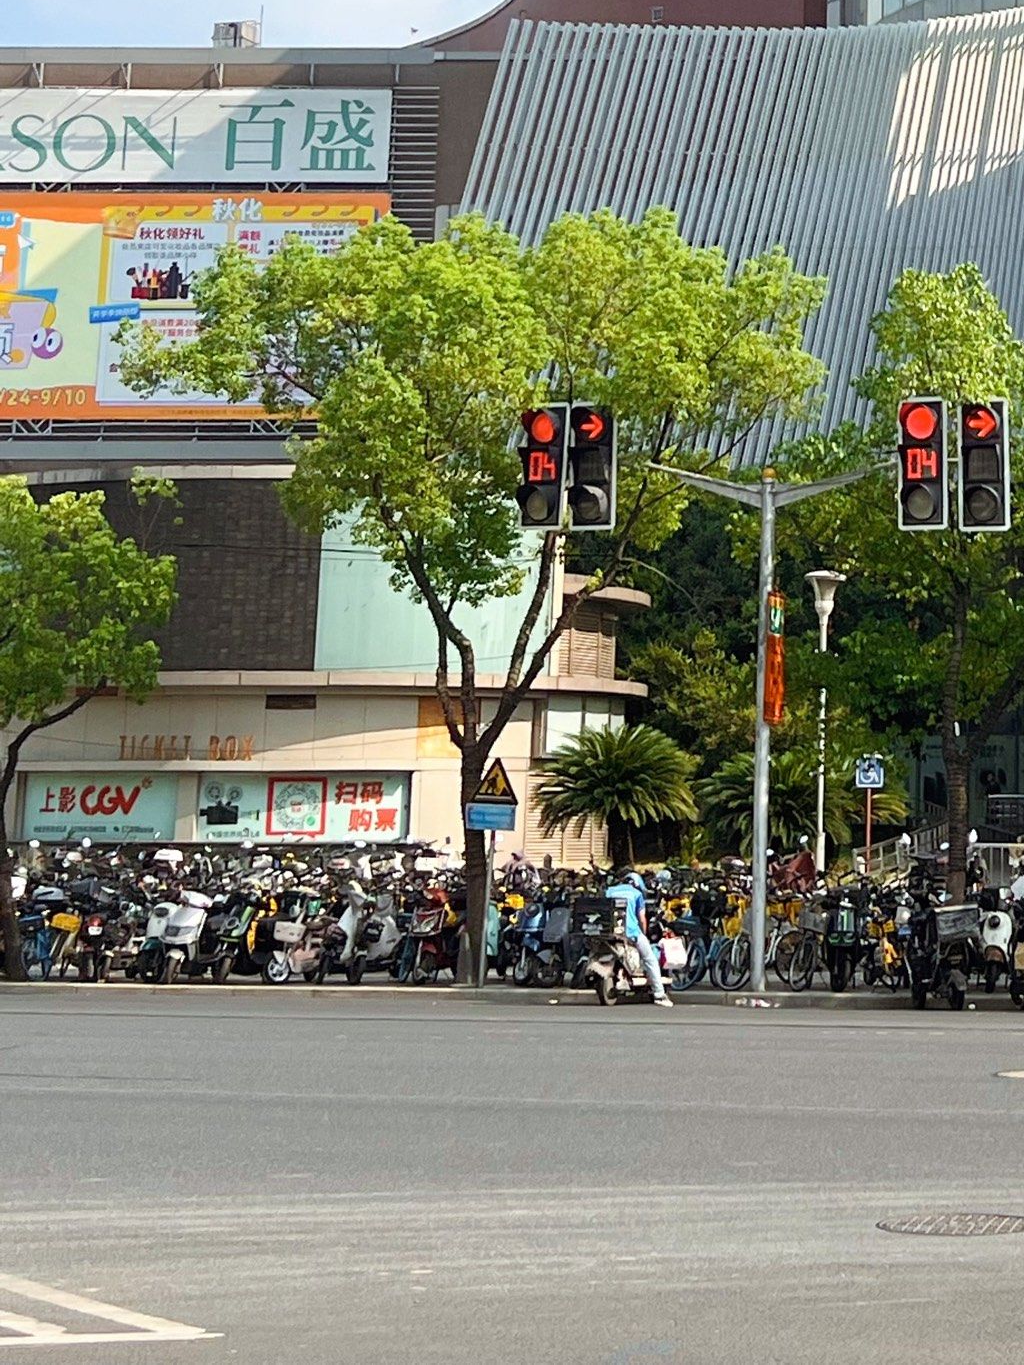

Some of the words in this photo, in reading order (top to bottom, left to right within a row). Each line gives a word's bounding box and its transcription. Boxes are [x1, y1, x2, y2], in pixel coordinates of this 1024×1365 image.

[0, 114, 177, 173] SON
[219, 99, 376, 172] 百盛
[211, 197, 264, 222] 秋化
[528, 451, 556, 481] 04
[907, 448, 937, 479] 04
[208, 735, 255, 760] BOX
[39, 786, 76, 813] 上影
[80, 784, 142, 816] CGV
[334, 781, 384, 805] 扫码
[348, 808, 398, 832] 购票
